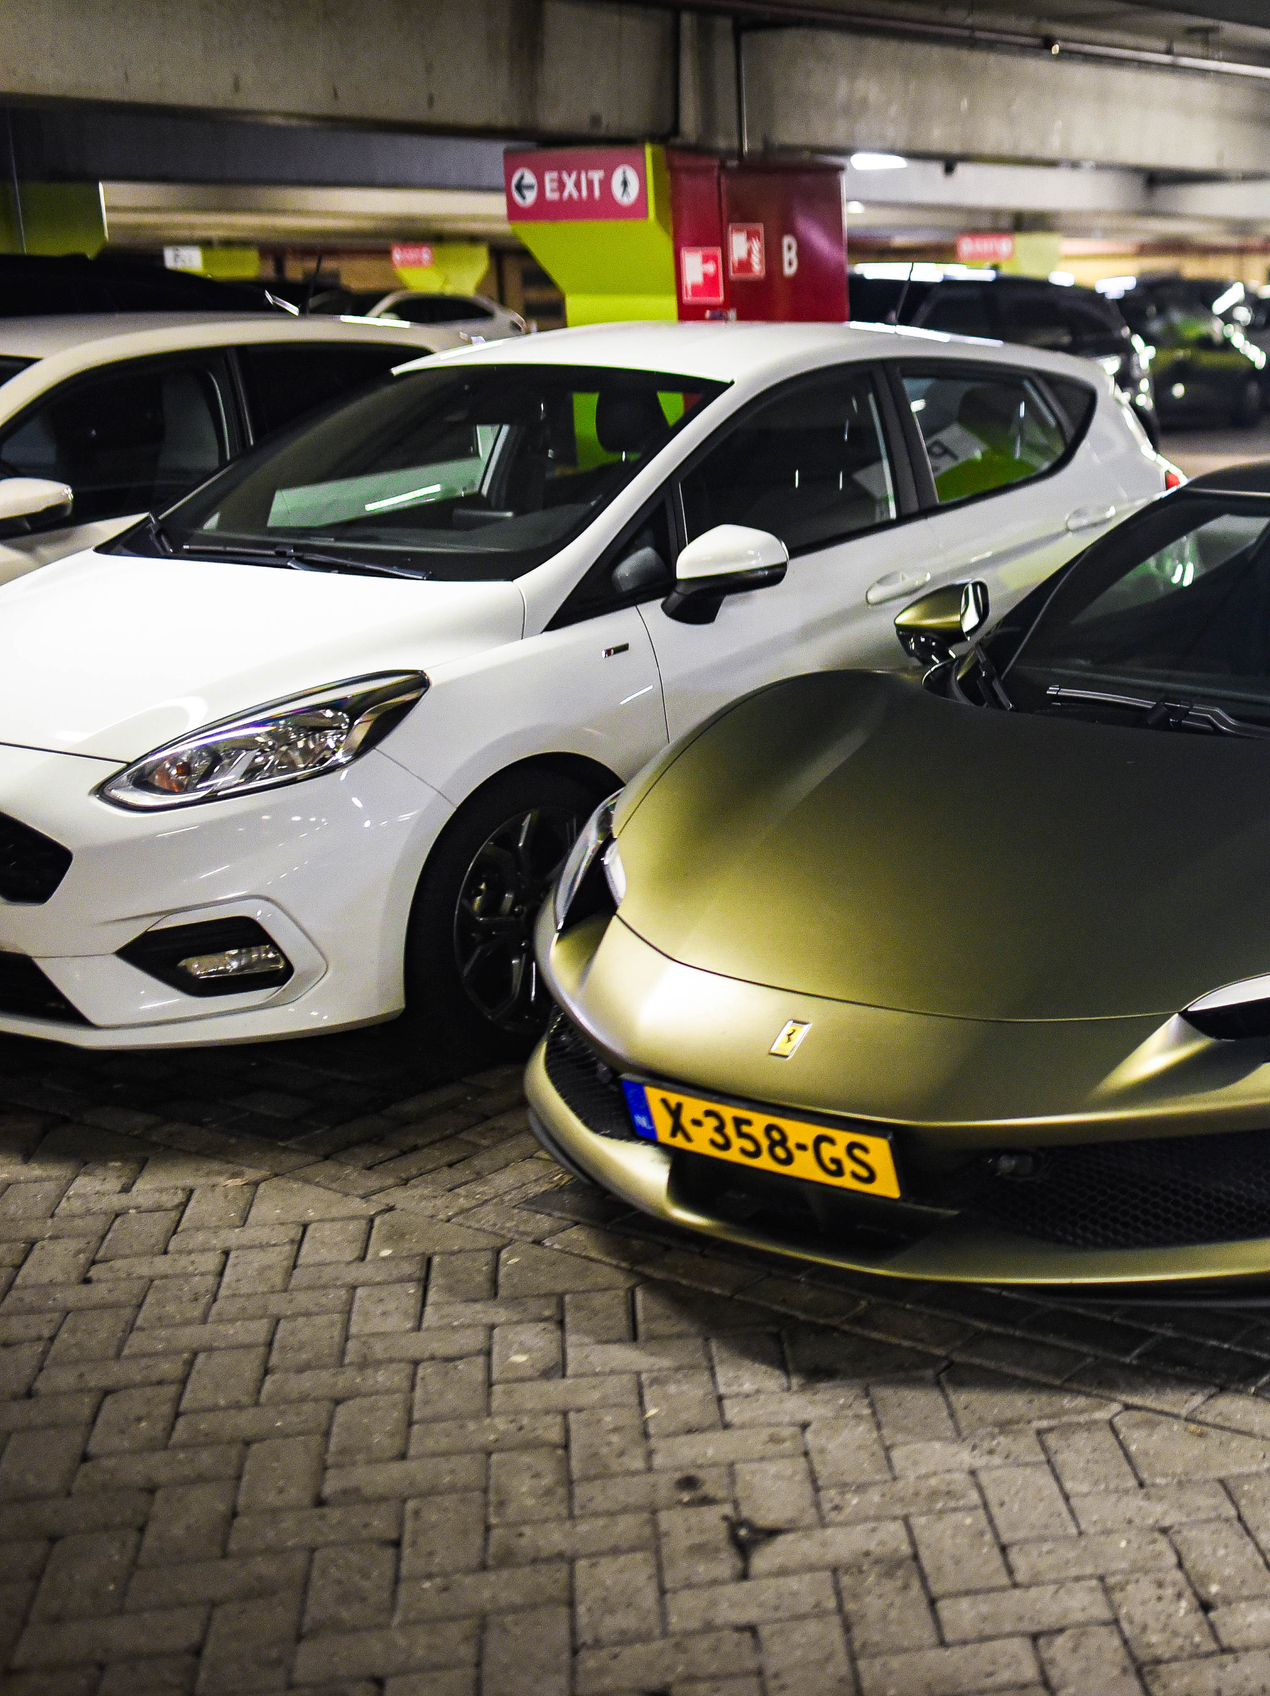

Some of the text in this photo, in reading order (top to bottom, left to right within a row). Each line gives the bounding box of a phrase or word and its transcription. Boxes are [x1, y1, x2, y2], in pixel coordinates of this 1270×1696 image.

[543, 169, 605, 201] EXIT
[781, 233, 799, 278] B
[660, 1097, 877, 1185] X-358-GS
